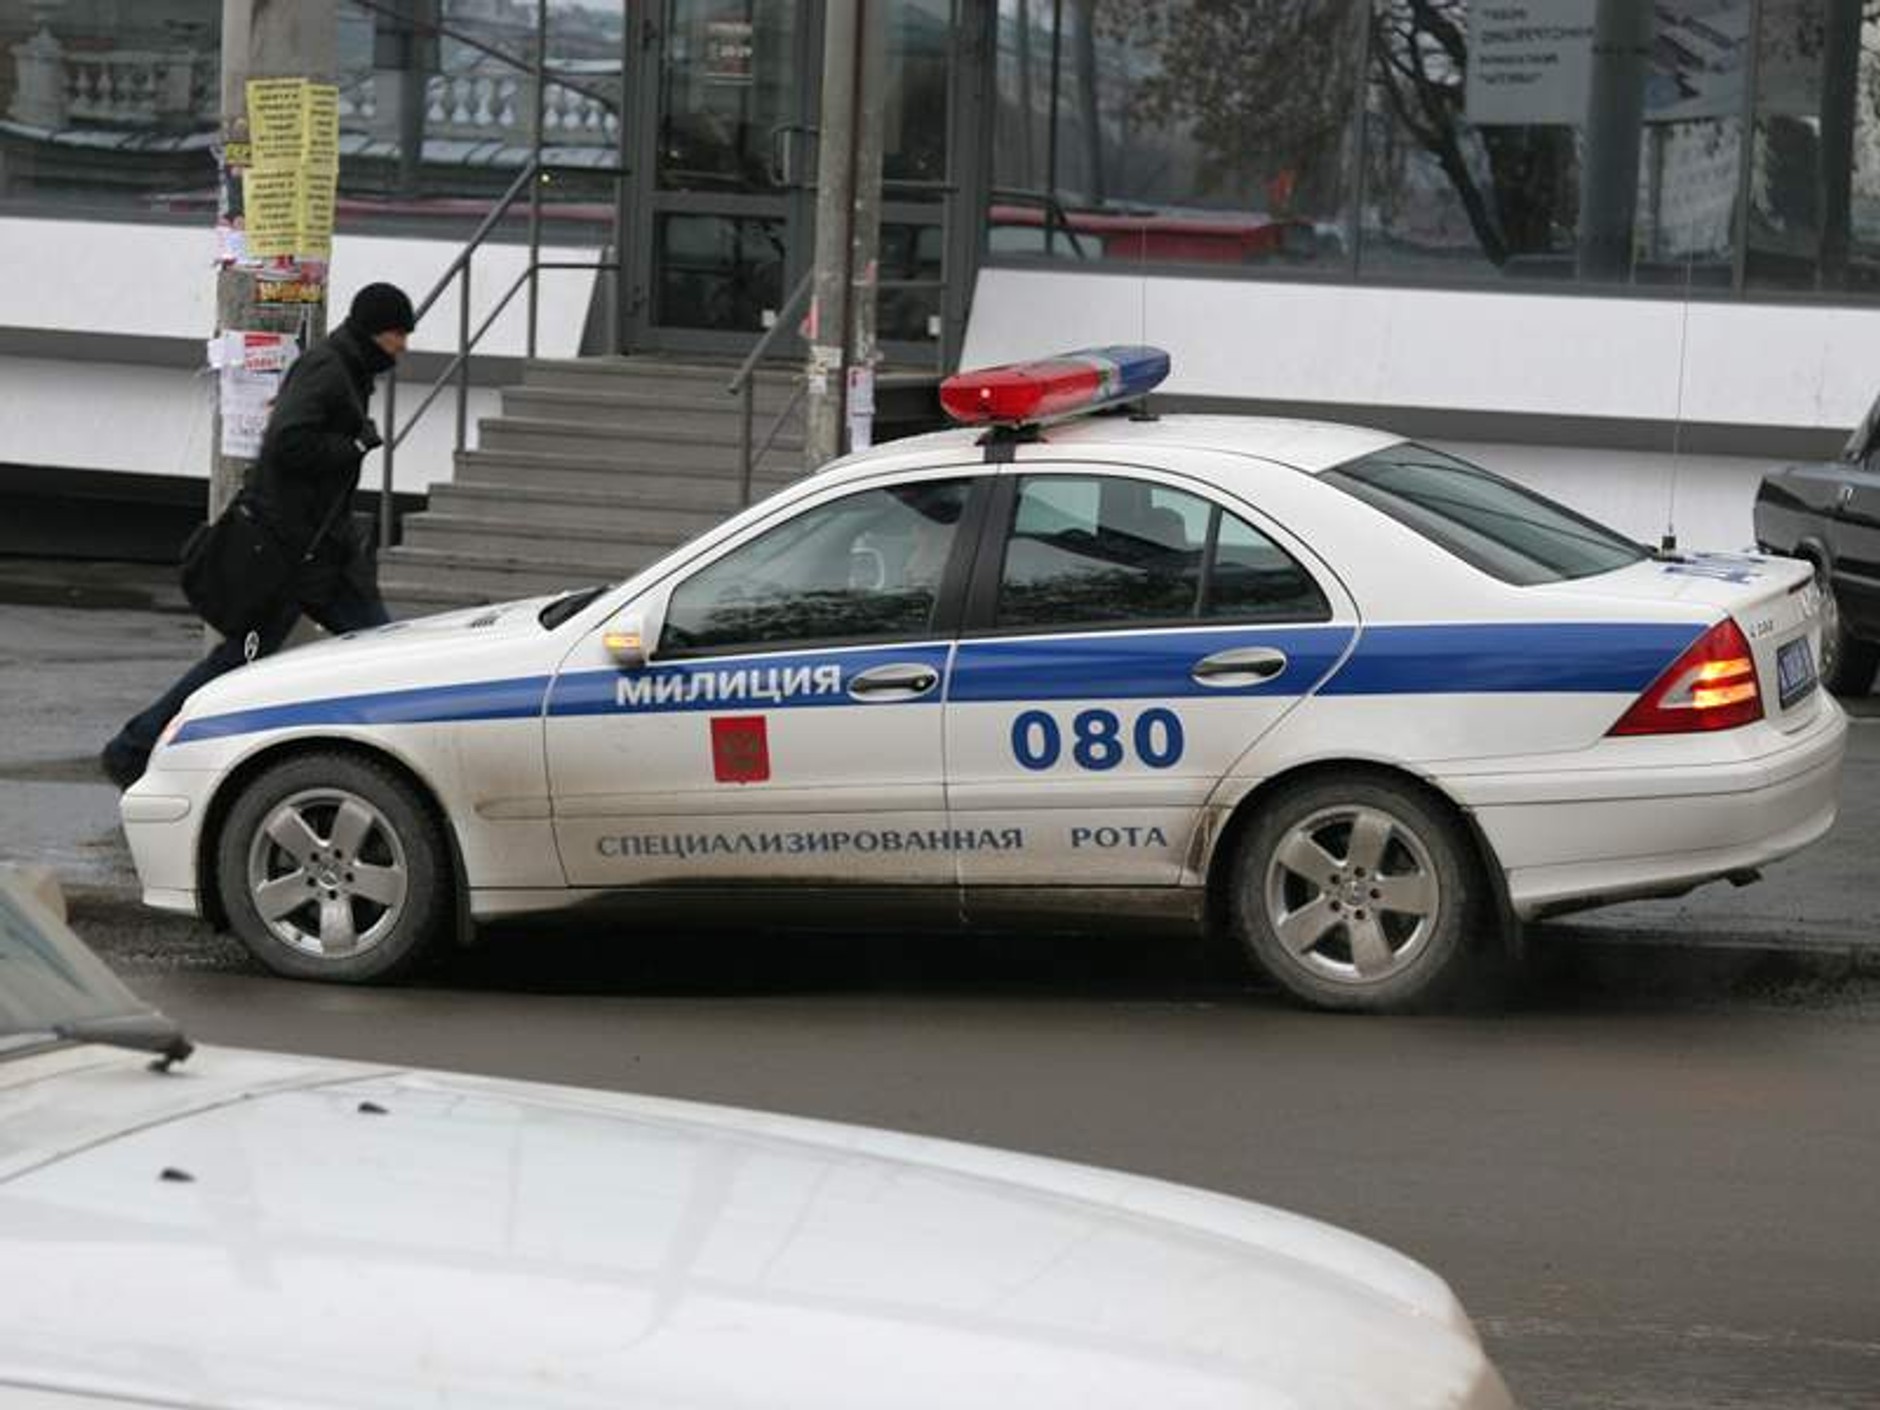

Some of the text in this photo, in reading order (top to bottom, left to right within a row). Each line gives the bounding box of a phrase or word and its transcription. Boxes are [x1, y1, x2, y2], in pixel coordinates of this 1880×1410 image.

[615, 664, 841, 706] МИЛИЦИЯ
[1011, 707, 1185, 771] 080
[596, 825, 1168, 859] СПЕЦИАЛИЗИРОВАННАЯ РОТА
